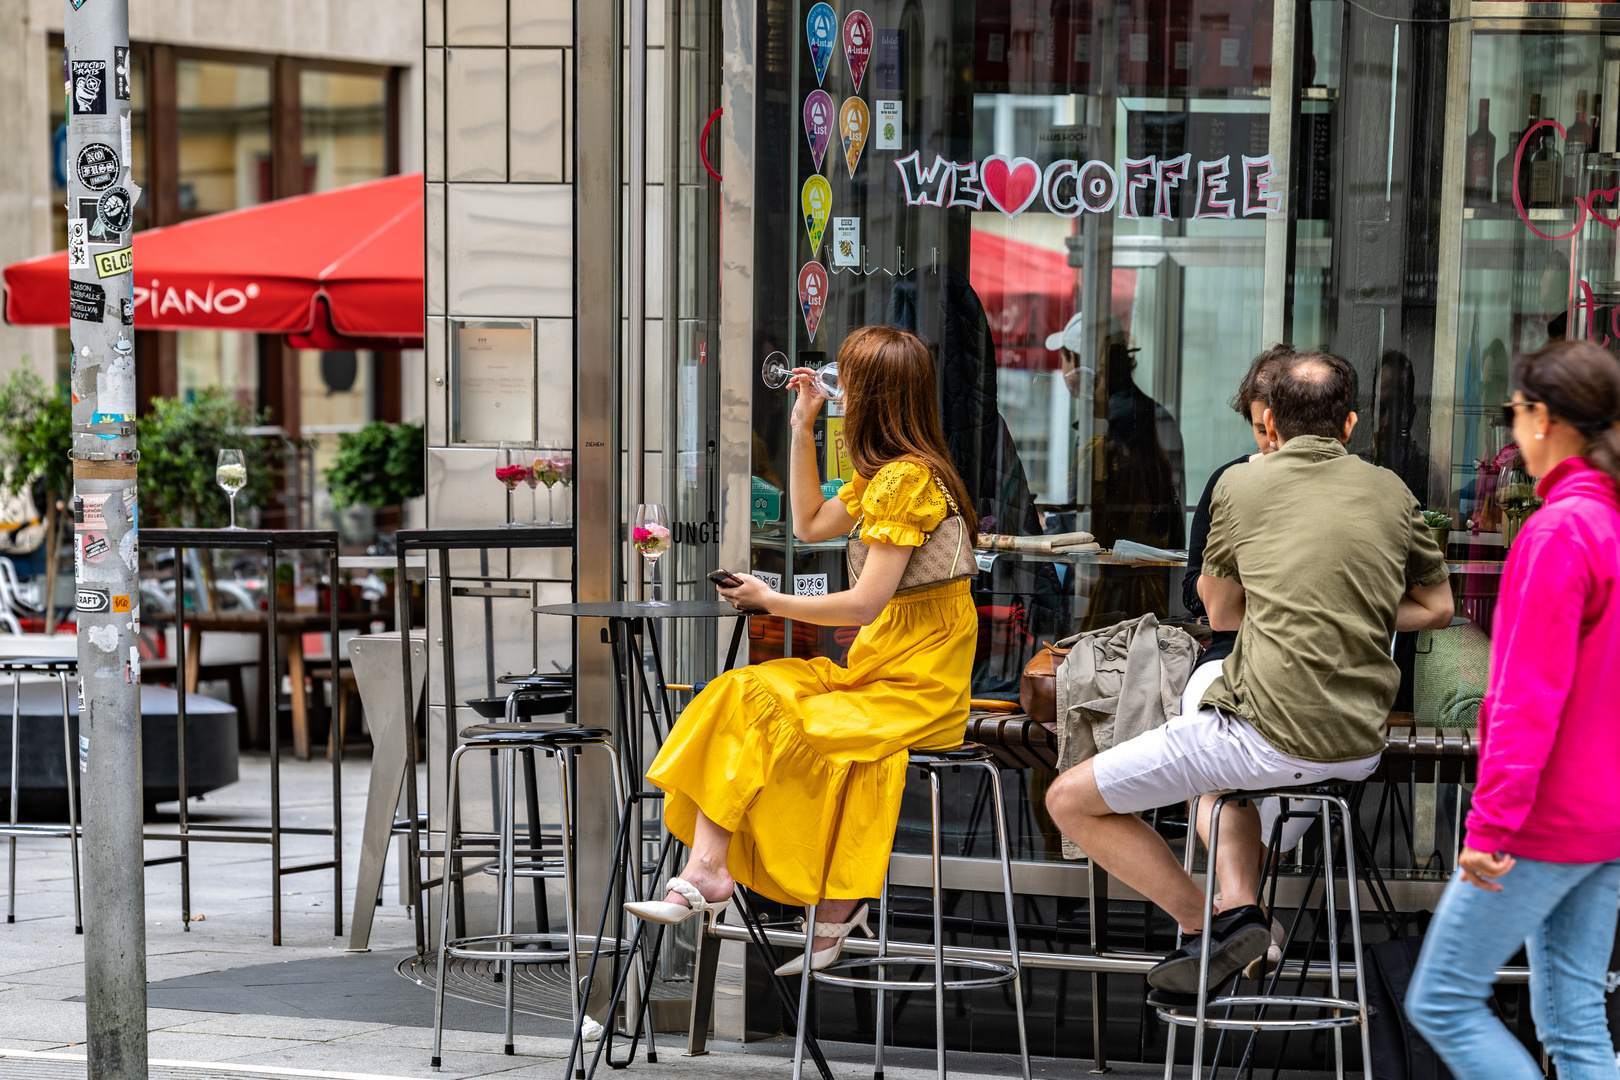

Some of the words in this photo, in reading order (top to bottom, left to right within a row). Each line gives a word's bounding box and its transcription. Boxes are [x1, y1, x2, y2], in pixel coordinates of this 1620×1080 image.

[72, 61, 106, 71] INFECTED
[75, 68, 100, 76] RATS
[1039, 133, 1061, 142] HAUS
[1062, 132, 1088, 142] HOCH
[86, 151, 104, 163] NO
[893, 149, 985, 211] WE
[1043, 152, 1283, 220] COFFEE
[74, 282, 92, 292] JASON
[672, 521, 719, 544] UNGE
[79, 596, 98, 605] RAFT
